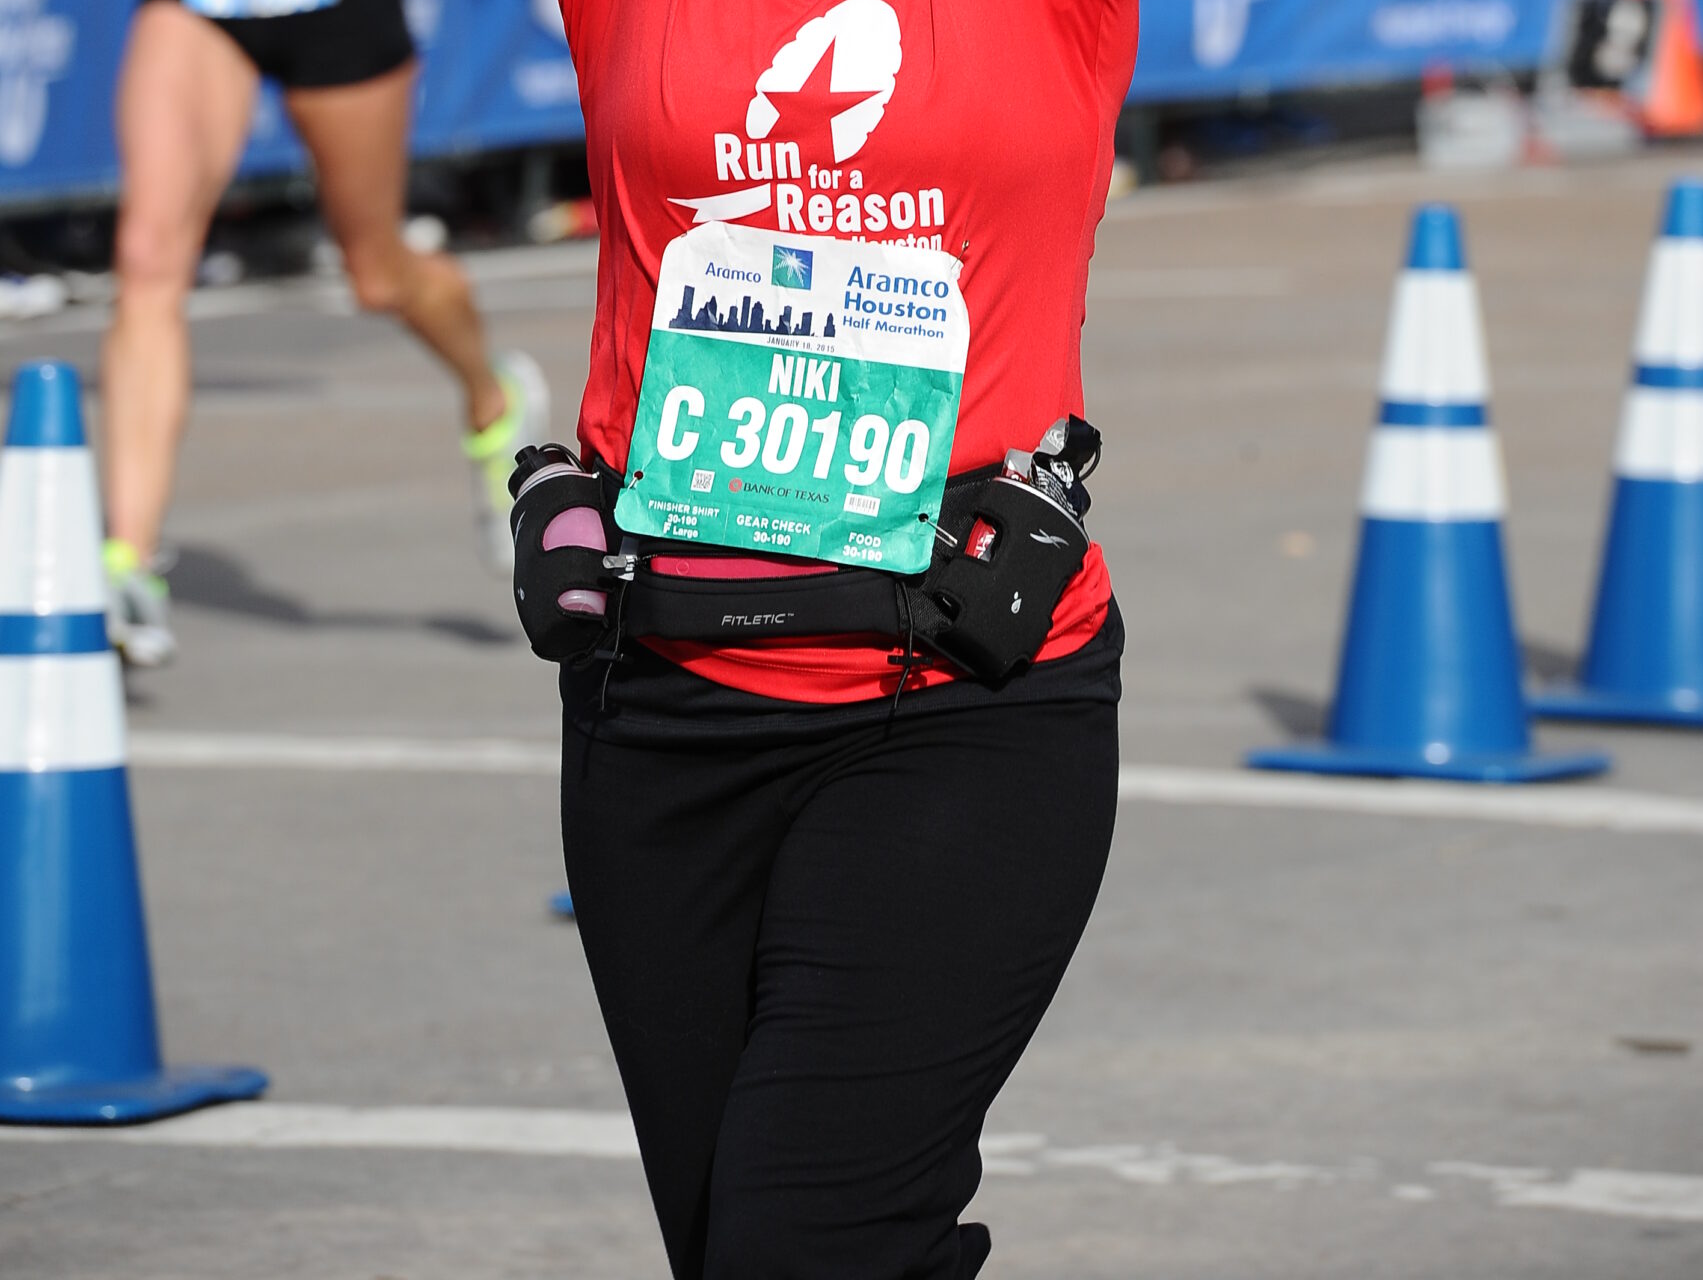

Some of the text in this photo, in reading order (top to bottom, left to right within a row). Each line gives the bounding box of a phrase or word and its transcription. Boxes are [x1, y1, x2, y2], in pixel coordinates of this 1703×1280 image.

[714, 132, 802, 182] Run
[808, 164, 863, 190] for a
[776, 183, 946, 233] Reason
[851, 233, 942, 252] ston
[705, 261, 762, 283] Aramco
[847, 266, 949, 298] Aramco
[844, 291, 947, 322] Houston
[843, 315, 944, 339] Half Marathon
[768, 352, 842, 403] NIKI
[656, 385, 705, 461] C
[719, 396, 931, 495] 30190
[743, 482, 830, 504] BANK OF TEXAS
[648, 499, 720, 518] FINISHER SHIRT
[673, 525, 699, 539] Large
[736, 514, 811, 535] GEAR CHECK
[753, 530, 791, 546] 30-190
[848, 531, 881, 548] FOOD
